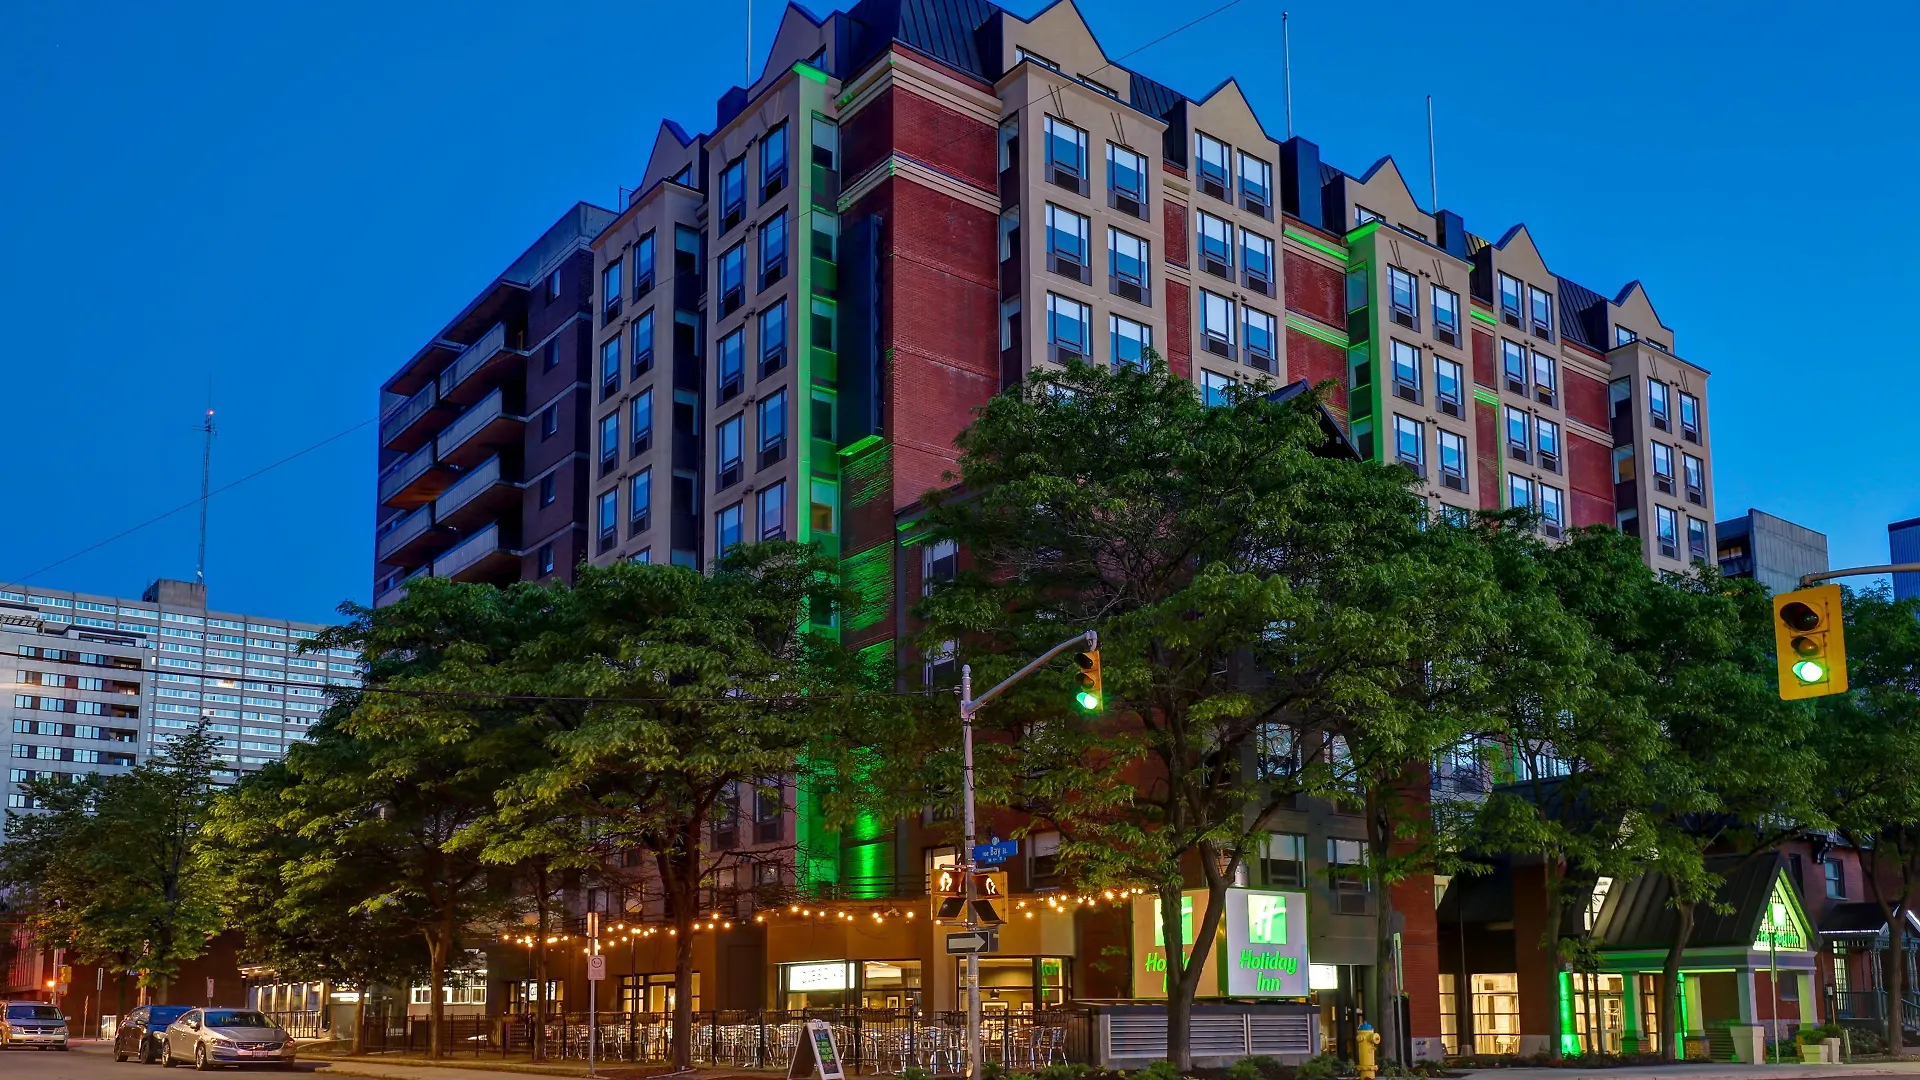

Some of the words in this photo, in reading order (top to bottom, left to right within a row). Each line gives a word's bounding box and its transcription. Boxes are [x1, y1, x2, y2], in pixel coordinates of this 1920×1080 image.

[990, 846, 1001, 857] Bay
[1239, 949, 1299, 975] Holiday
[1256, 971, 1282, 992] Inn
